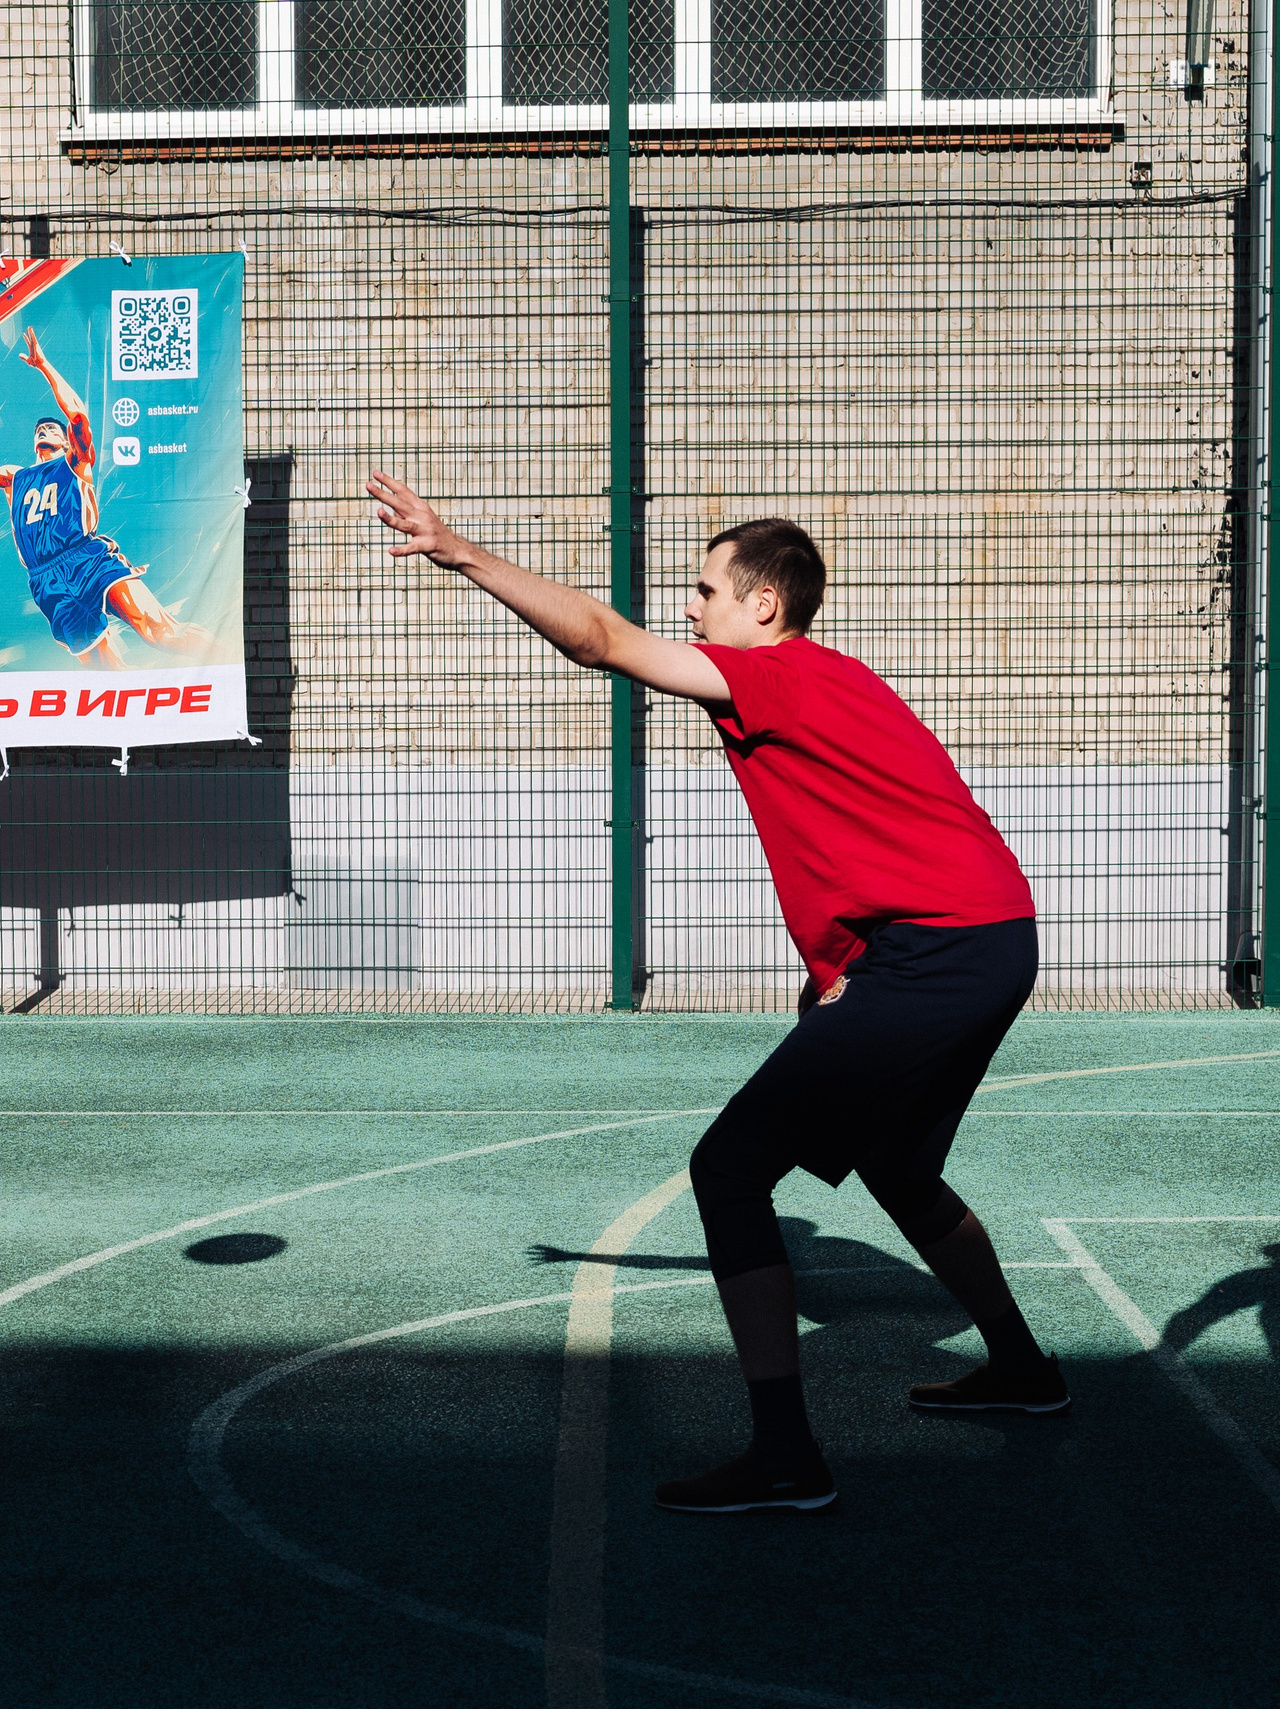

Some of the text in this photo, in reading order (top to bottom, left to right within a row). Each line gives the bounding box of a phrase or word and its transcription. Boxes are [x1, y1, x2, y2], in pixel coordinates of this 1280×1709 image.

[147, 404, 199, 416] asbasket.ru
[148, 442, 187, 454] asbasket
[23, 482, 58, 525] 24
[29, 690, 67, 717] В
[76, 684, 212, 717] ИГРЕ
